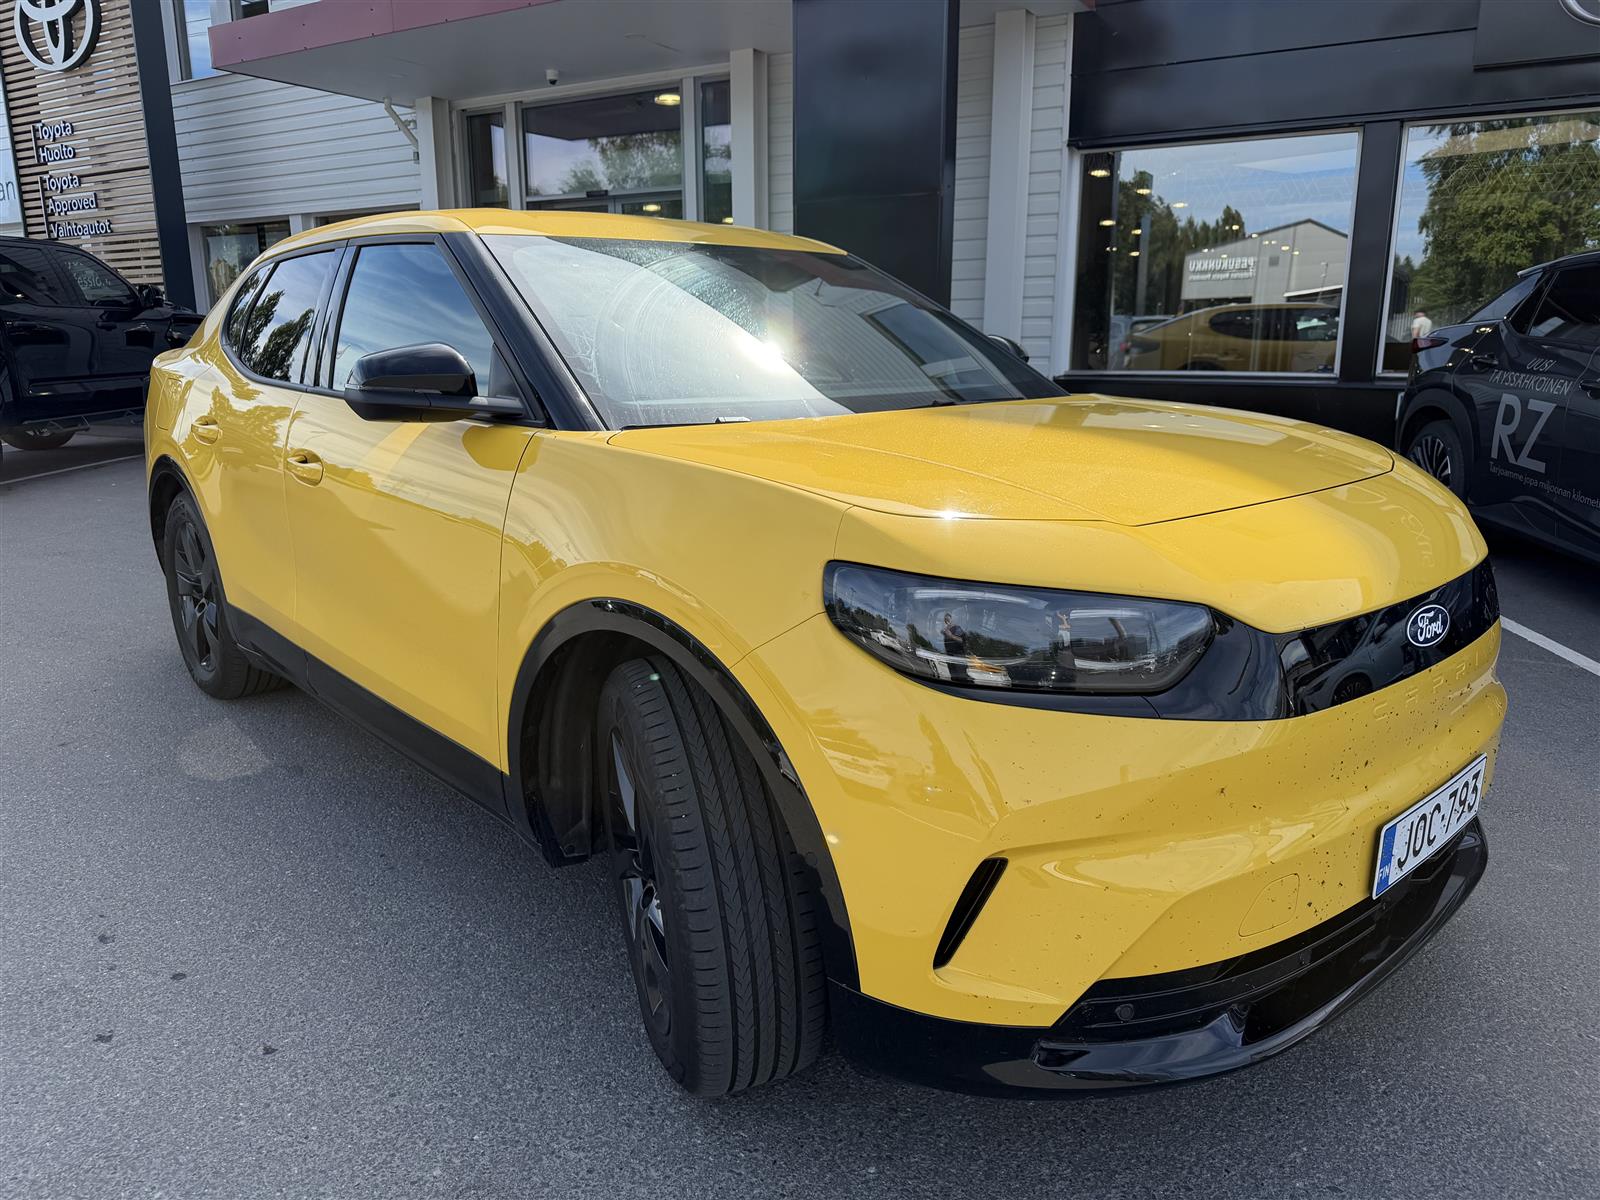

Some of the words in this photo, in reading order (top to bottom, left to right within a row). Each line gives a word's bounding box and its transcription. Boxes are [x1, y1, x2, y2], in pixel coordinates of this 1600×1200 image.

[37, 121, 73, 142] Toyota
[39, 147, 75, 163] Huolto
[44, 175, 80, 194] Toyota
[48, 194, 97, 216] Approved
[50, 220, 111, 238] Vaihtoautot
[1526, 358, 1557, 372] UUSI
[1490, 393, 1557, 474] RZ
[1489, 461, 1524, 482] Tarjoamme
[1523, 475, 1538, 487] jopa
[1539, 481, 1571, 498] miljoonan
[1417, 611, 1443, 641] Ford
[1397, 769, 1482, 870] JOC-793
[1378, 863, 1391, 881] FIN
